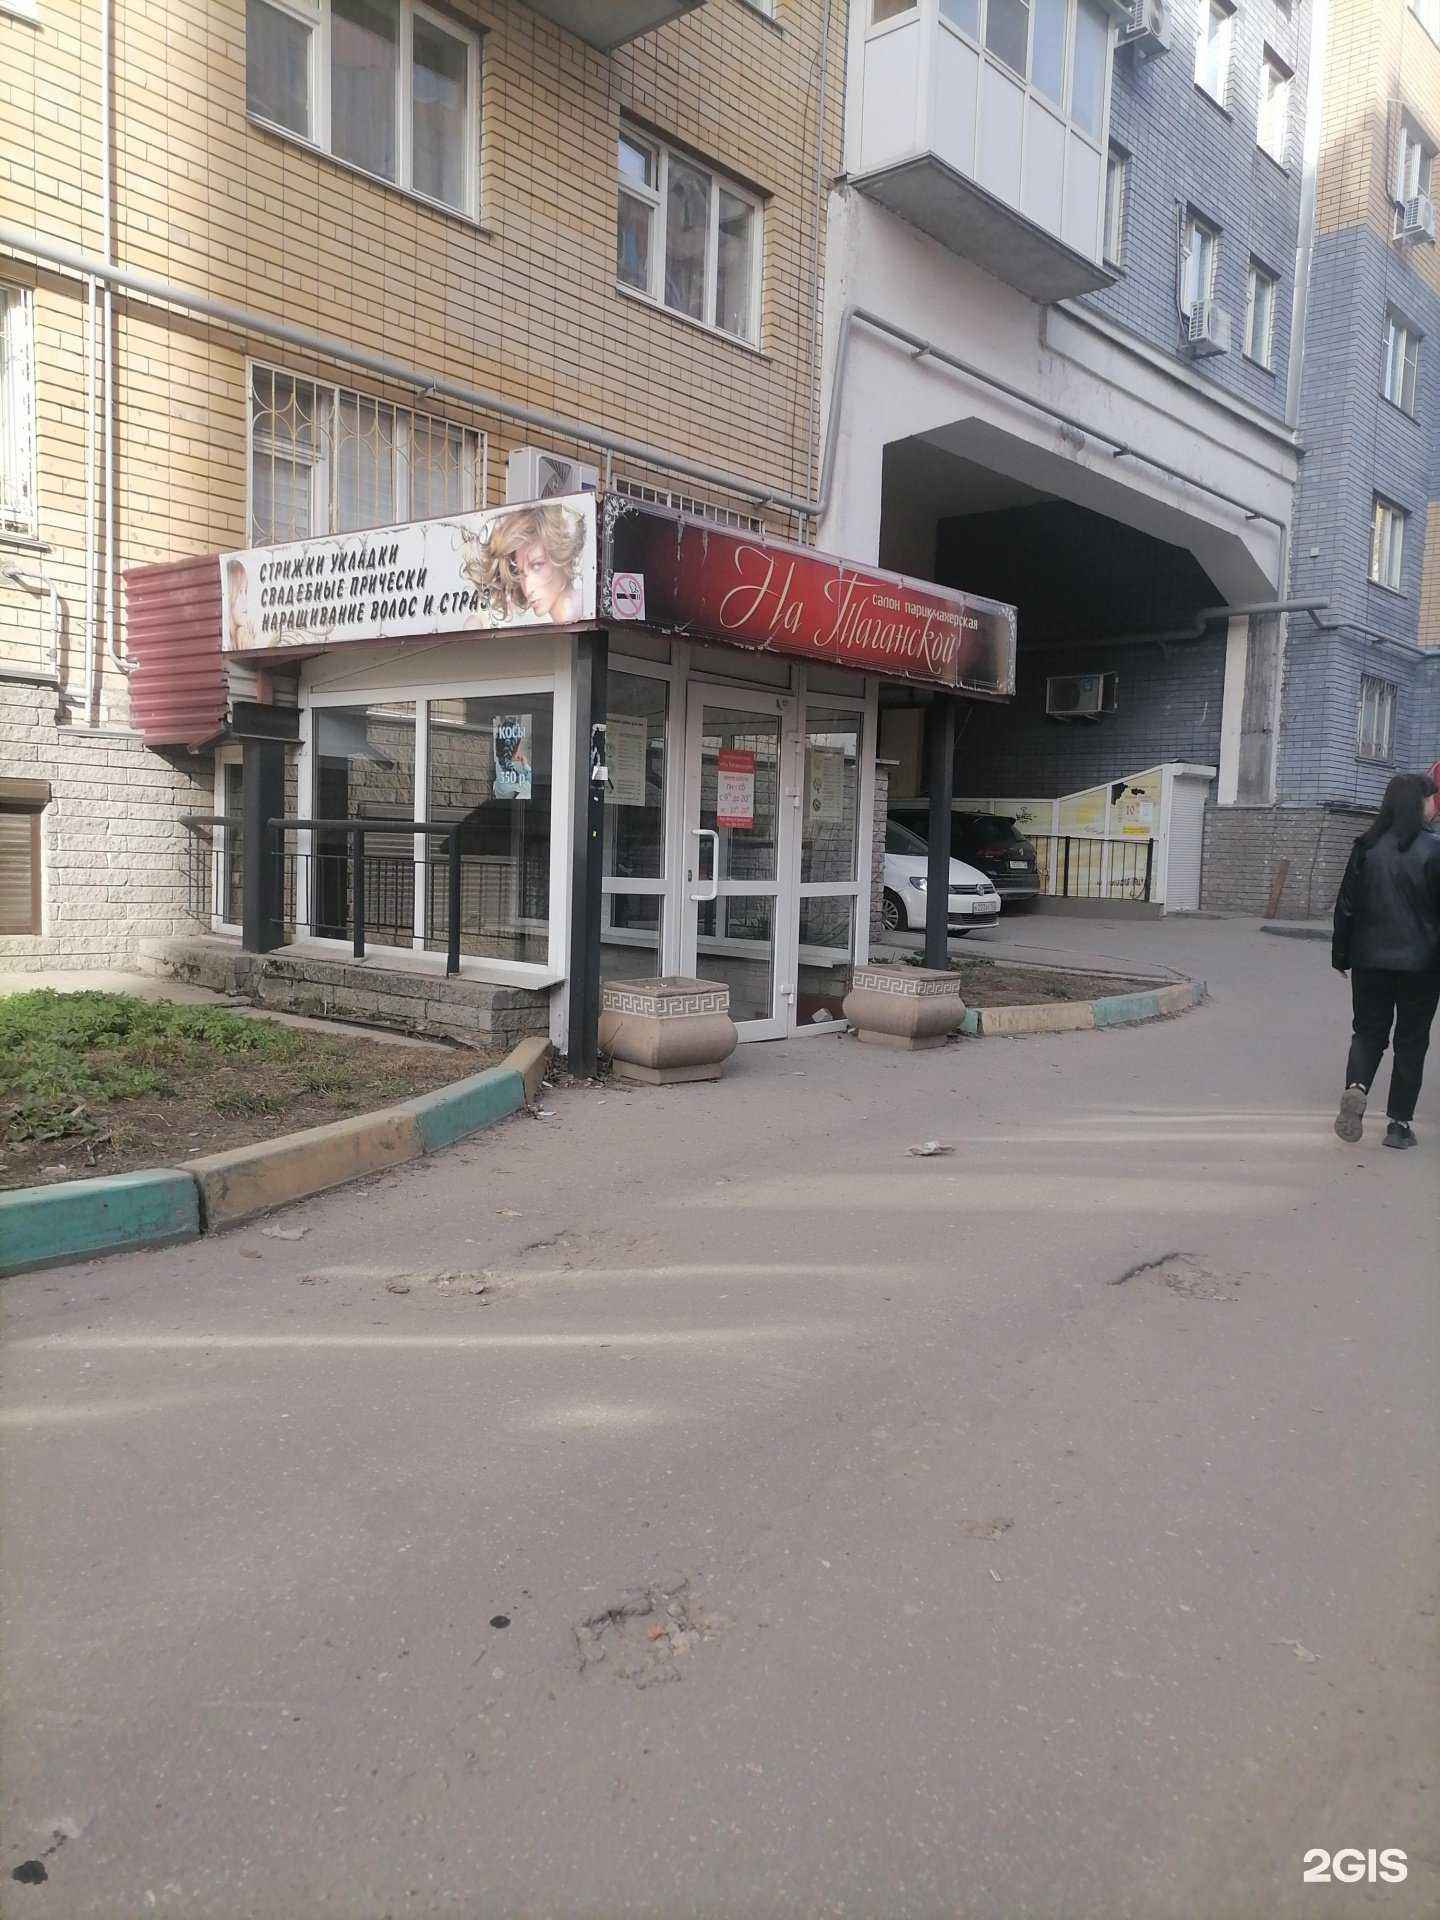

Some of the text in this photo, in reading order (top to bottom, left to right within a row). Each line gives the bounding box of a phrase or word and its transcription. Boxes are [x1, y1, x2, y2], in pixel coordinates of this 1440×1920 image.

[260, 544, 399, 584] СТРИЖКИ УКЛАДКИ
[261, 567, 428, 608] СВАДЕБНЫЕ ПРИЧЕСКИ
[872, 593, 901, 611] салон
[262, 602, 365, 632] НАРАЩИВАНИЕ
[371, 596, 417, 622] ВОЛОС
[423, 594, 434, 616] И
[720, 546, 957, 674] На Таганской
